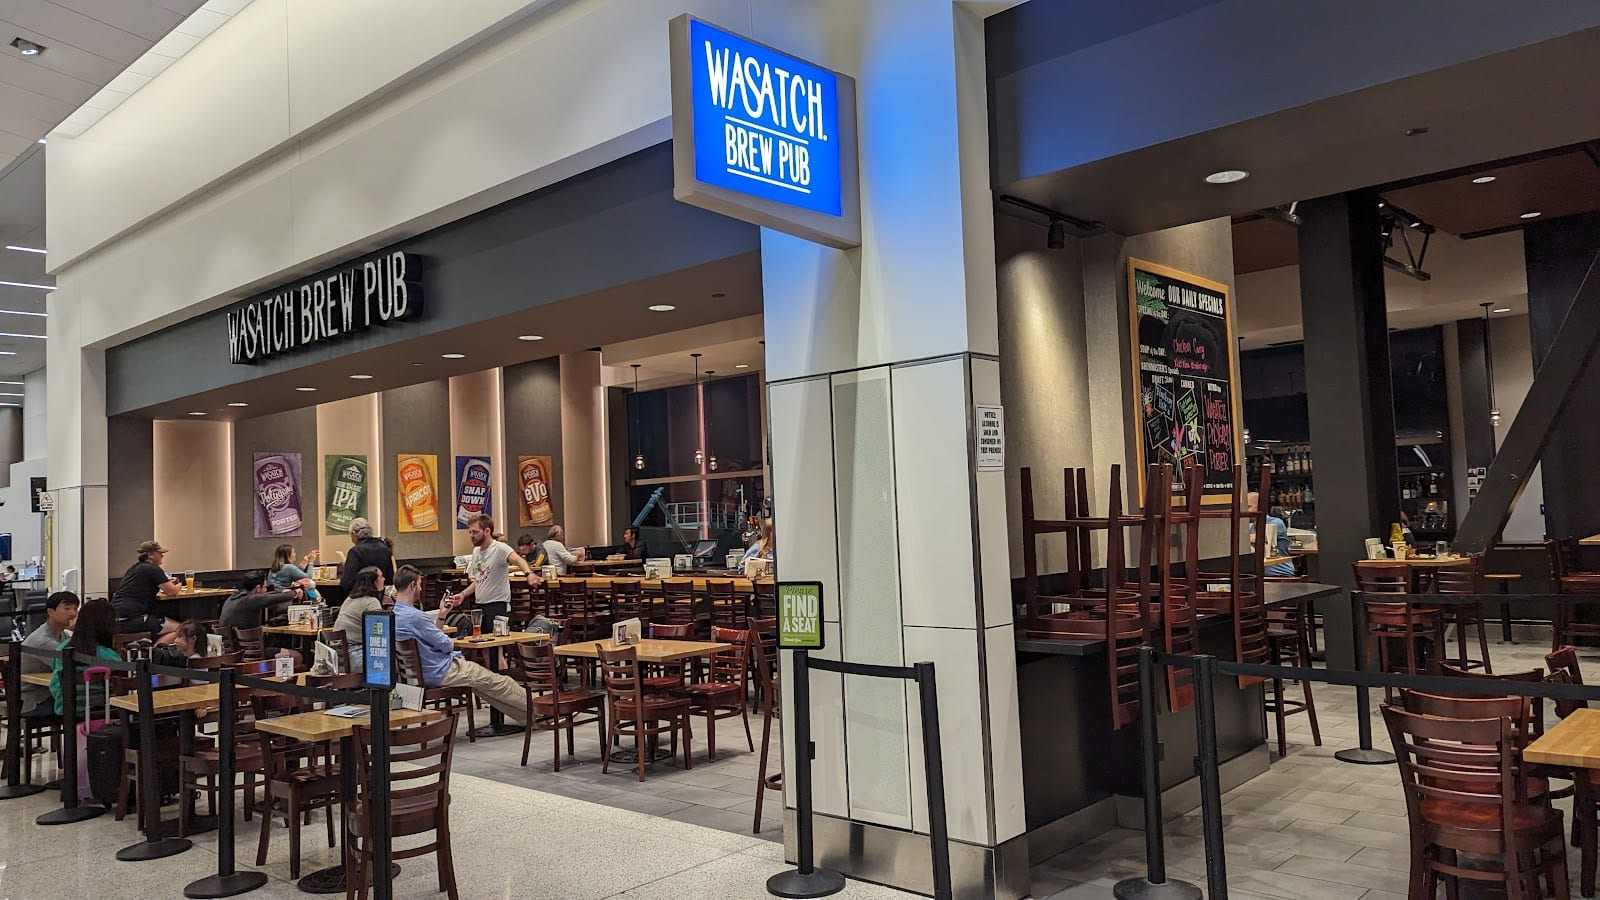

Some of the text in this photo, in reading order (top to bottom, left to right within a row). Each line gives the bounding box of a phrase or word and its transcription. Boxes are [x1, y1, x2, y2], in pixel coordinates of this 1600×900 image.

[725, 122, 811, 186] BREW PUB
[1136, 279, 1166, 300] Welcome
[227, 250, 408, 364] WASATCH BREW PUB
[1168, 285, 1223, 314] OUR DAILY SPECIALS
[333, 487, 358, 511] IPA
[406, 485, 431, 507] APRICOT
[461, 495, 485, 504] DOWN
[464, 486, 486, 495] SNAP
[272, 515, 297, 525] PORTER
[784, 595, 817, 617] FIND
[783, 617, 816, 633] A SEAT
[370, 637, 386, 647] DINE IN
[370, 648, 387, 657] SEATING
[374, 660, 384, 671] Only
